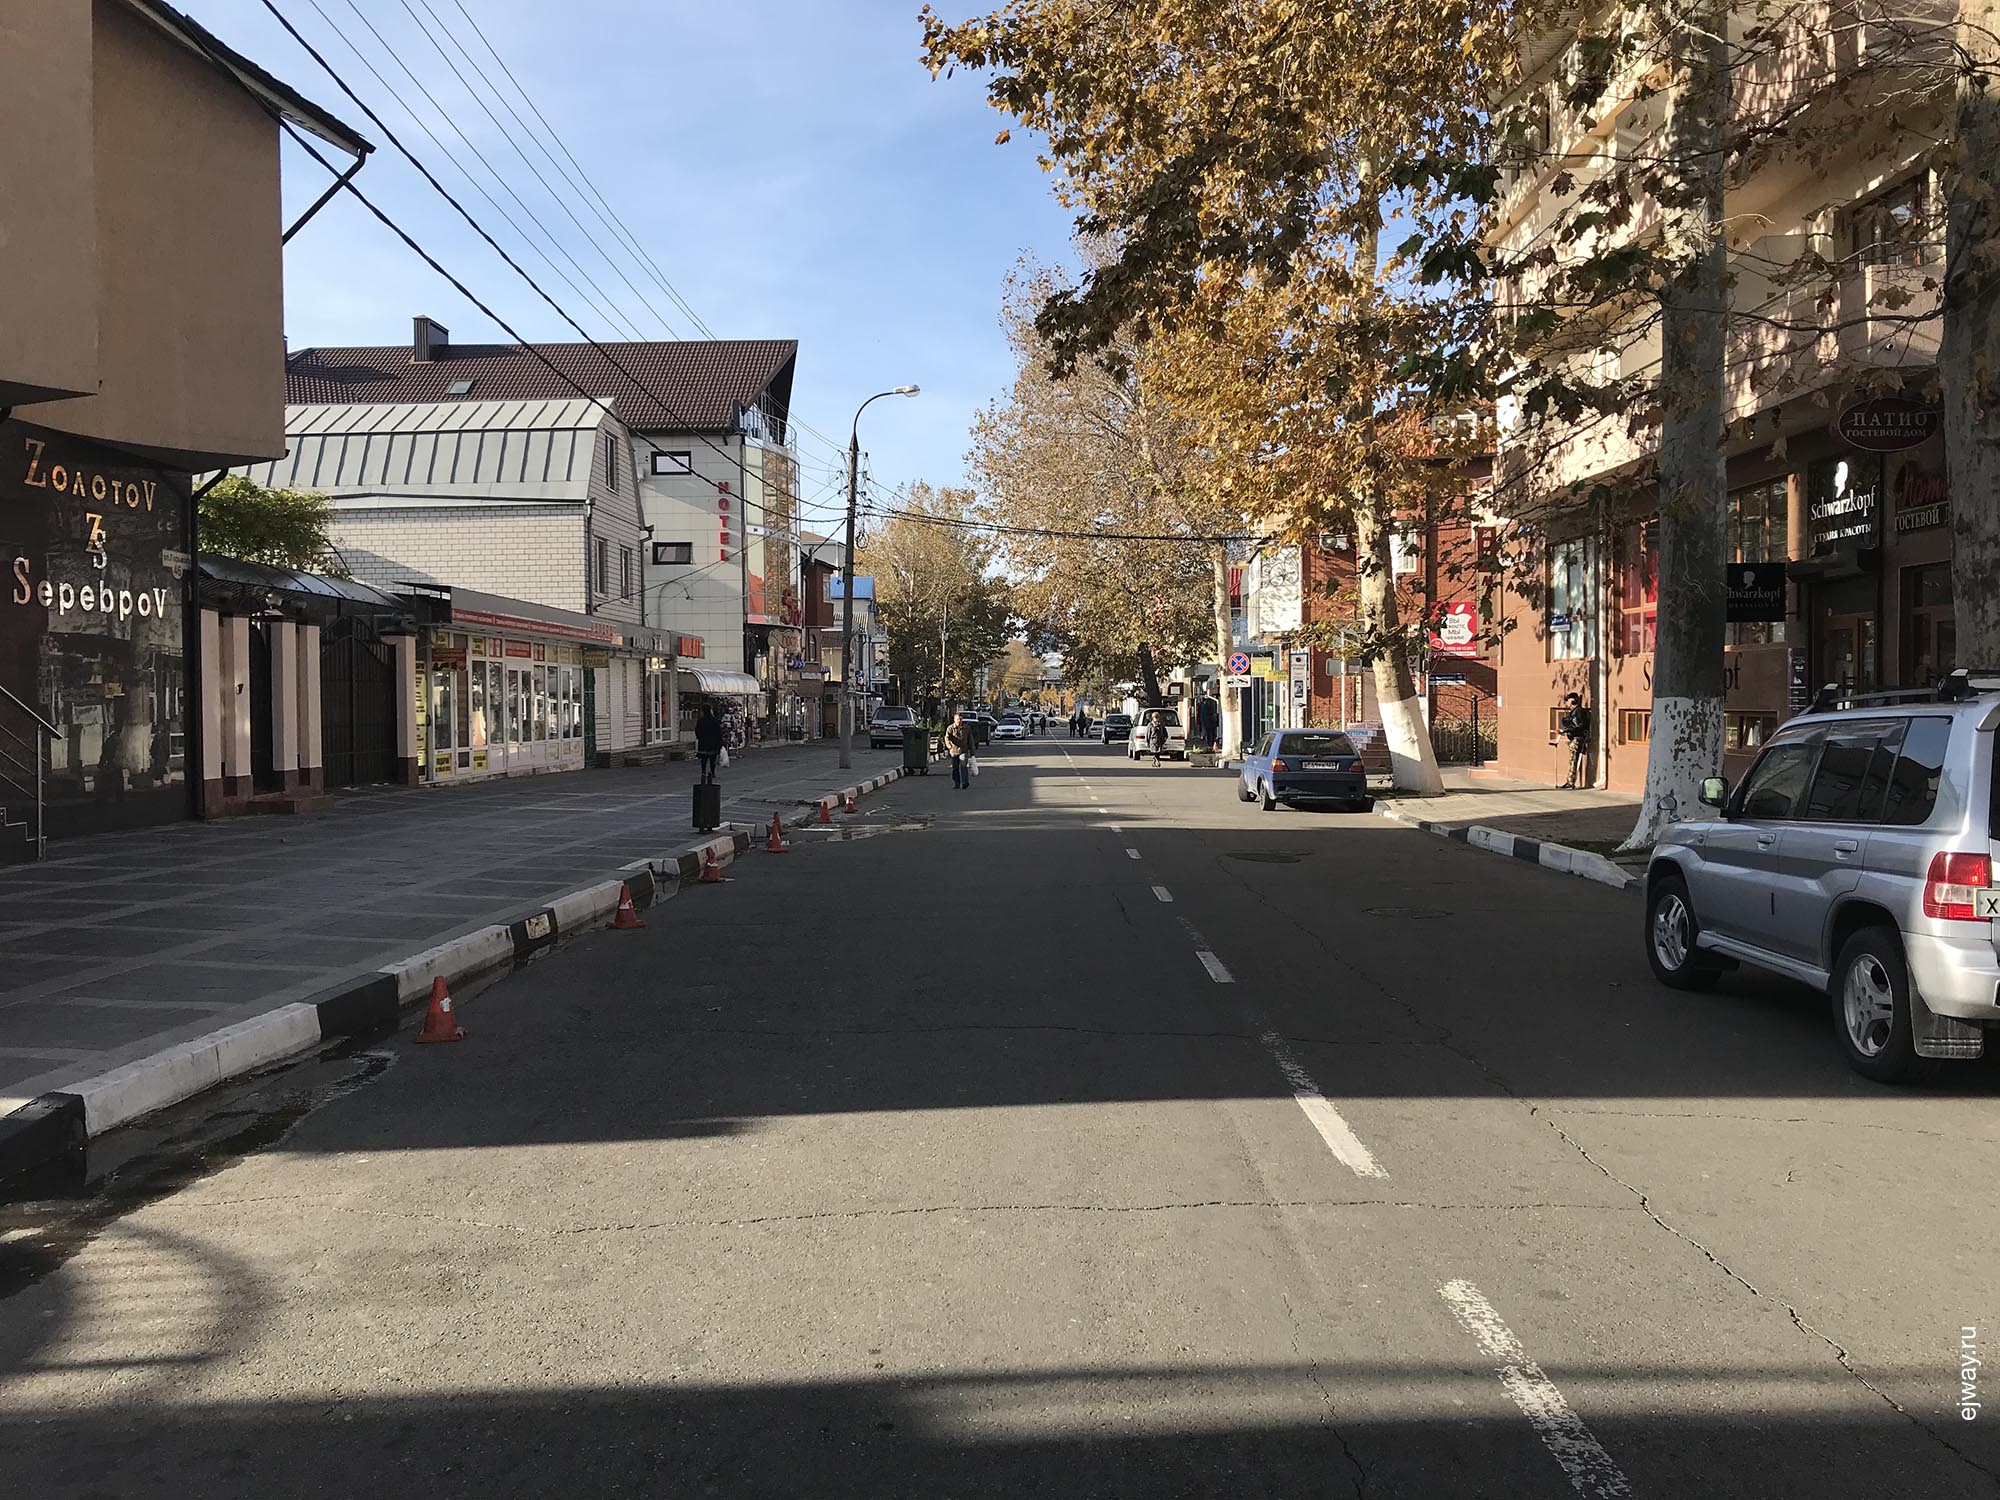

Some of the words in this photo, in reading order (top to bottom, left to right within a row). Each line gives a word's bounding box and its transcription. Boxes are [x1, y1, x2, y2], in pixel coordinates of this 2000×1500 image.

[1853, 411, 1928, 427] ПАТИО
[1846, 427, 1901, 438] ГОСТЕВОЙ
[1903, 429, 1927, 438] ДОМ
[1811, 484, 1876, 521] Schwarzkopf
[718, 481, 730, 562] HOTEL
[1894, 505, 1940, 531] ГОСТЕВОЙ
[1727, 586, 1781, 602] hwarzkopf
